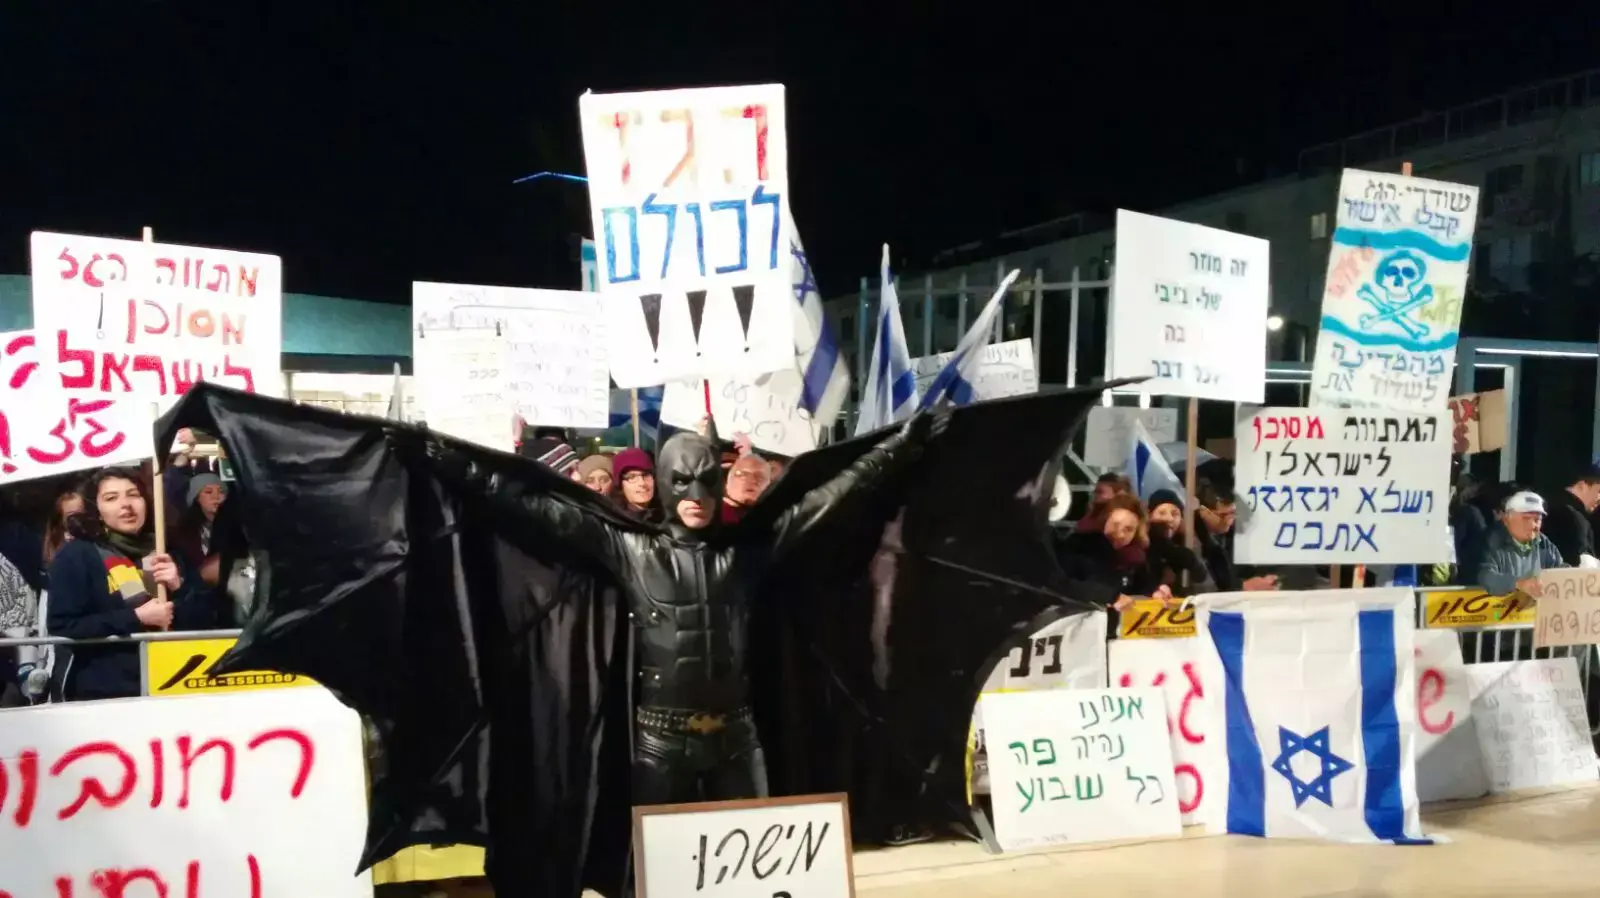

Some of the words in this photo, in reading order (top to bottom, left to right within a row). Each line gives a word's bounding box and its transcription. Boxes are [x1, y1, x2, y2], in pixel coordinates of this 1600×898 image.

[601, 185, 780, 284] לכולם
[154, 256, 259, 298] מתווה
[1189, 251, 1223, 273] מוזר
[1230, 257, 1248, 277] זה
[125, 298, 247, 345] מסוכן
[56, 328, 256, 396] לישראל
[1150, 359, 1184, 379] דבר
[1252, 415, 1325, 453] מסוכן
[1343, 415, 1438, 443] המתווה
[1273, 520, 1380, 553] אתכם
[1078, 694, 1144, 729] אנחנו
[1007, 738, 1057, 767] פה
[1070, 733, 1125, 761] נהיה
[1015, 773, 1105, 814] שבוע
[1125, 765, 1166, 805] כל
